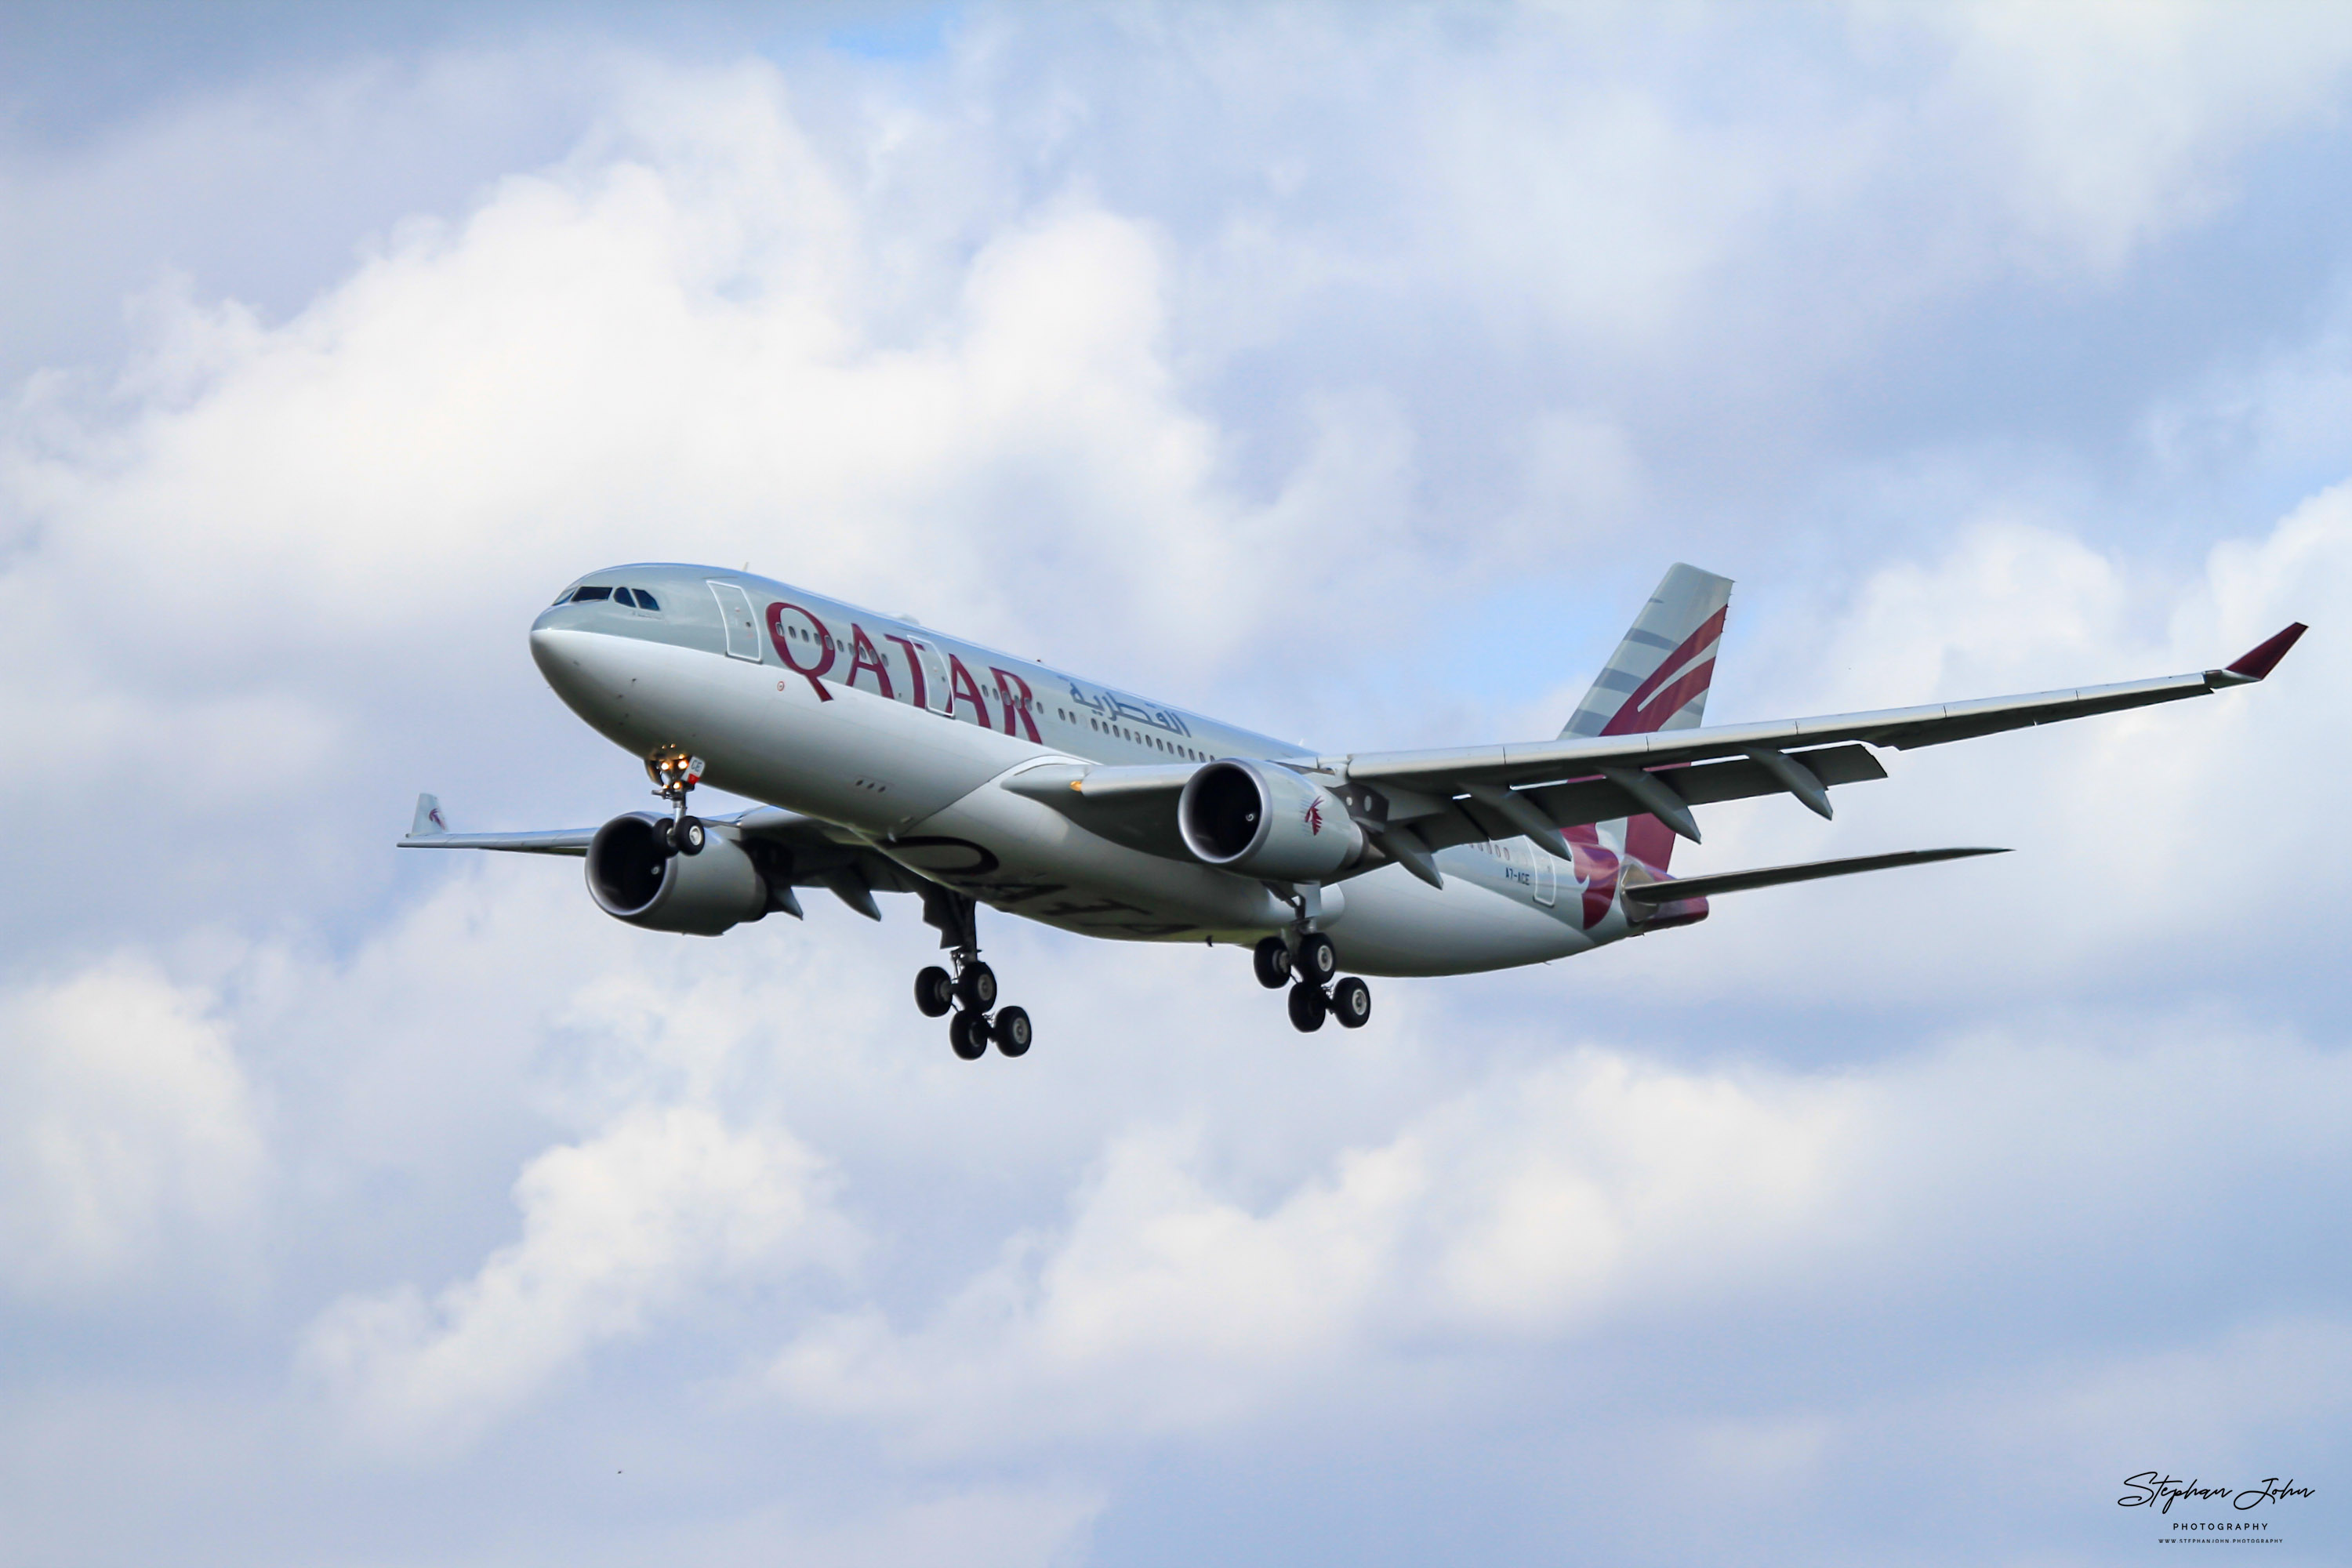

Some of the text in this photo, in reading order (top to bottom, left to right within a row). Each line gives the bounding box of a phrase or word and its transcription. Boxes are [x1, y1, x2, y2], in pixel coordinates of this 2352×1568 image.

[765, 602, 1043, 745] QATAR
[1057, 675, 1192, 739] القطرية
[1505, 867, 1530, 886] A7-ACE
